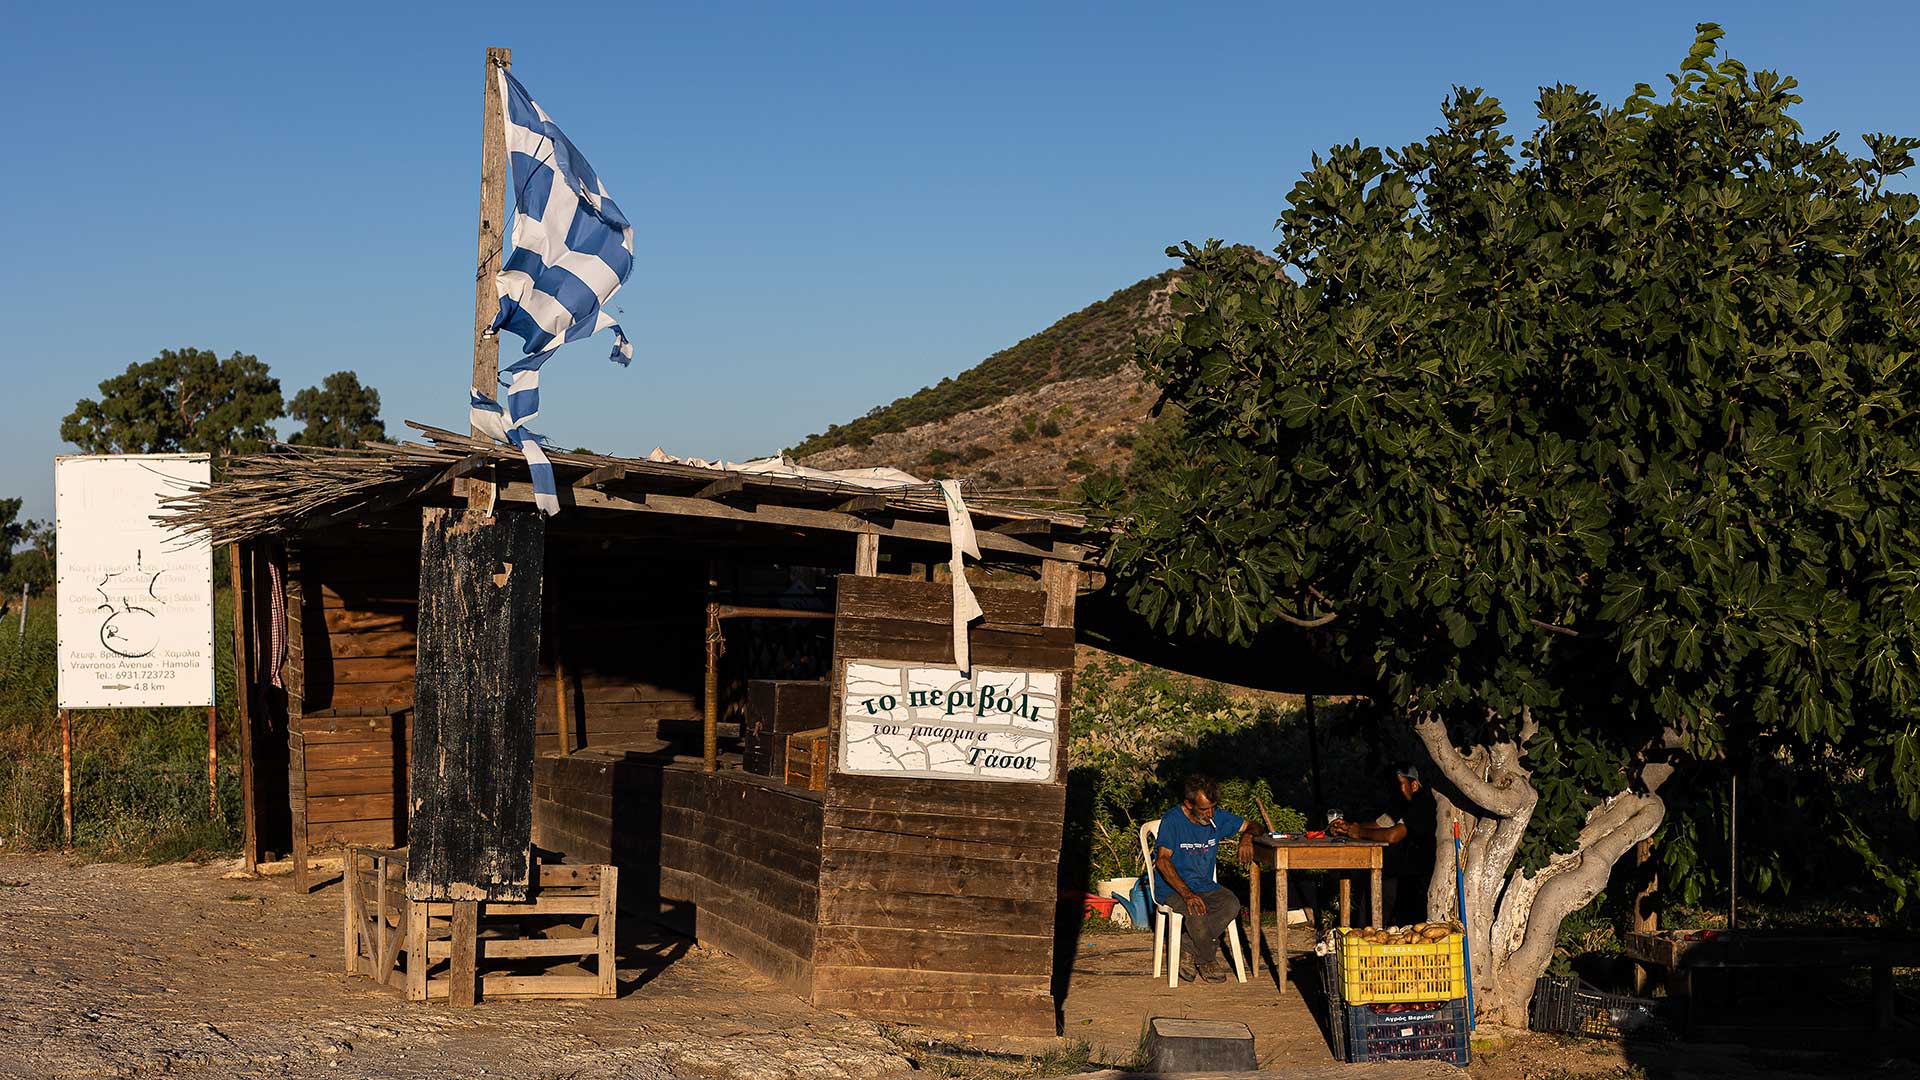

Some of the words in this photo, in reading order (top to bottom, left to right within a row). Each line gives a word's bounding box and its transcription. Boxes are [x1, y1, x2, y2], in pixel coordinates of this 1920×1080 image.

[70, 661, 116, 670] Vravronos
[119, 660, 154, 670] Avenue
[162, 660, 201, 669] Hamolia
[115, 671, 176, 680] 6931.723723
[133, 683, 149, 691] 4.8
[151, 683, 165, 691] km
[861, 694, 897, 715] το
[908, 685, 1041, 723] περιβόλι
[872, 724, 901, 736] του
[967, 746, 1038, 771] Τάσου
